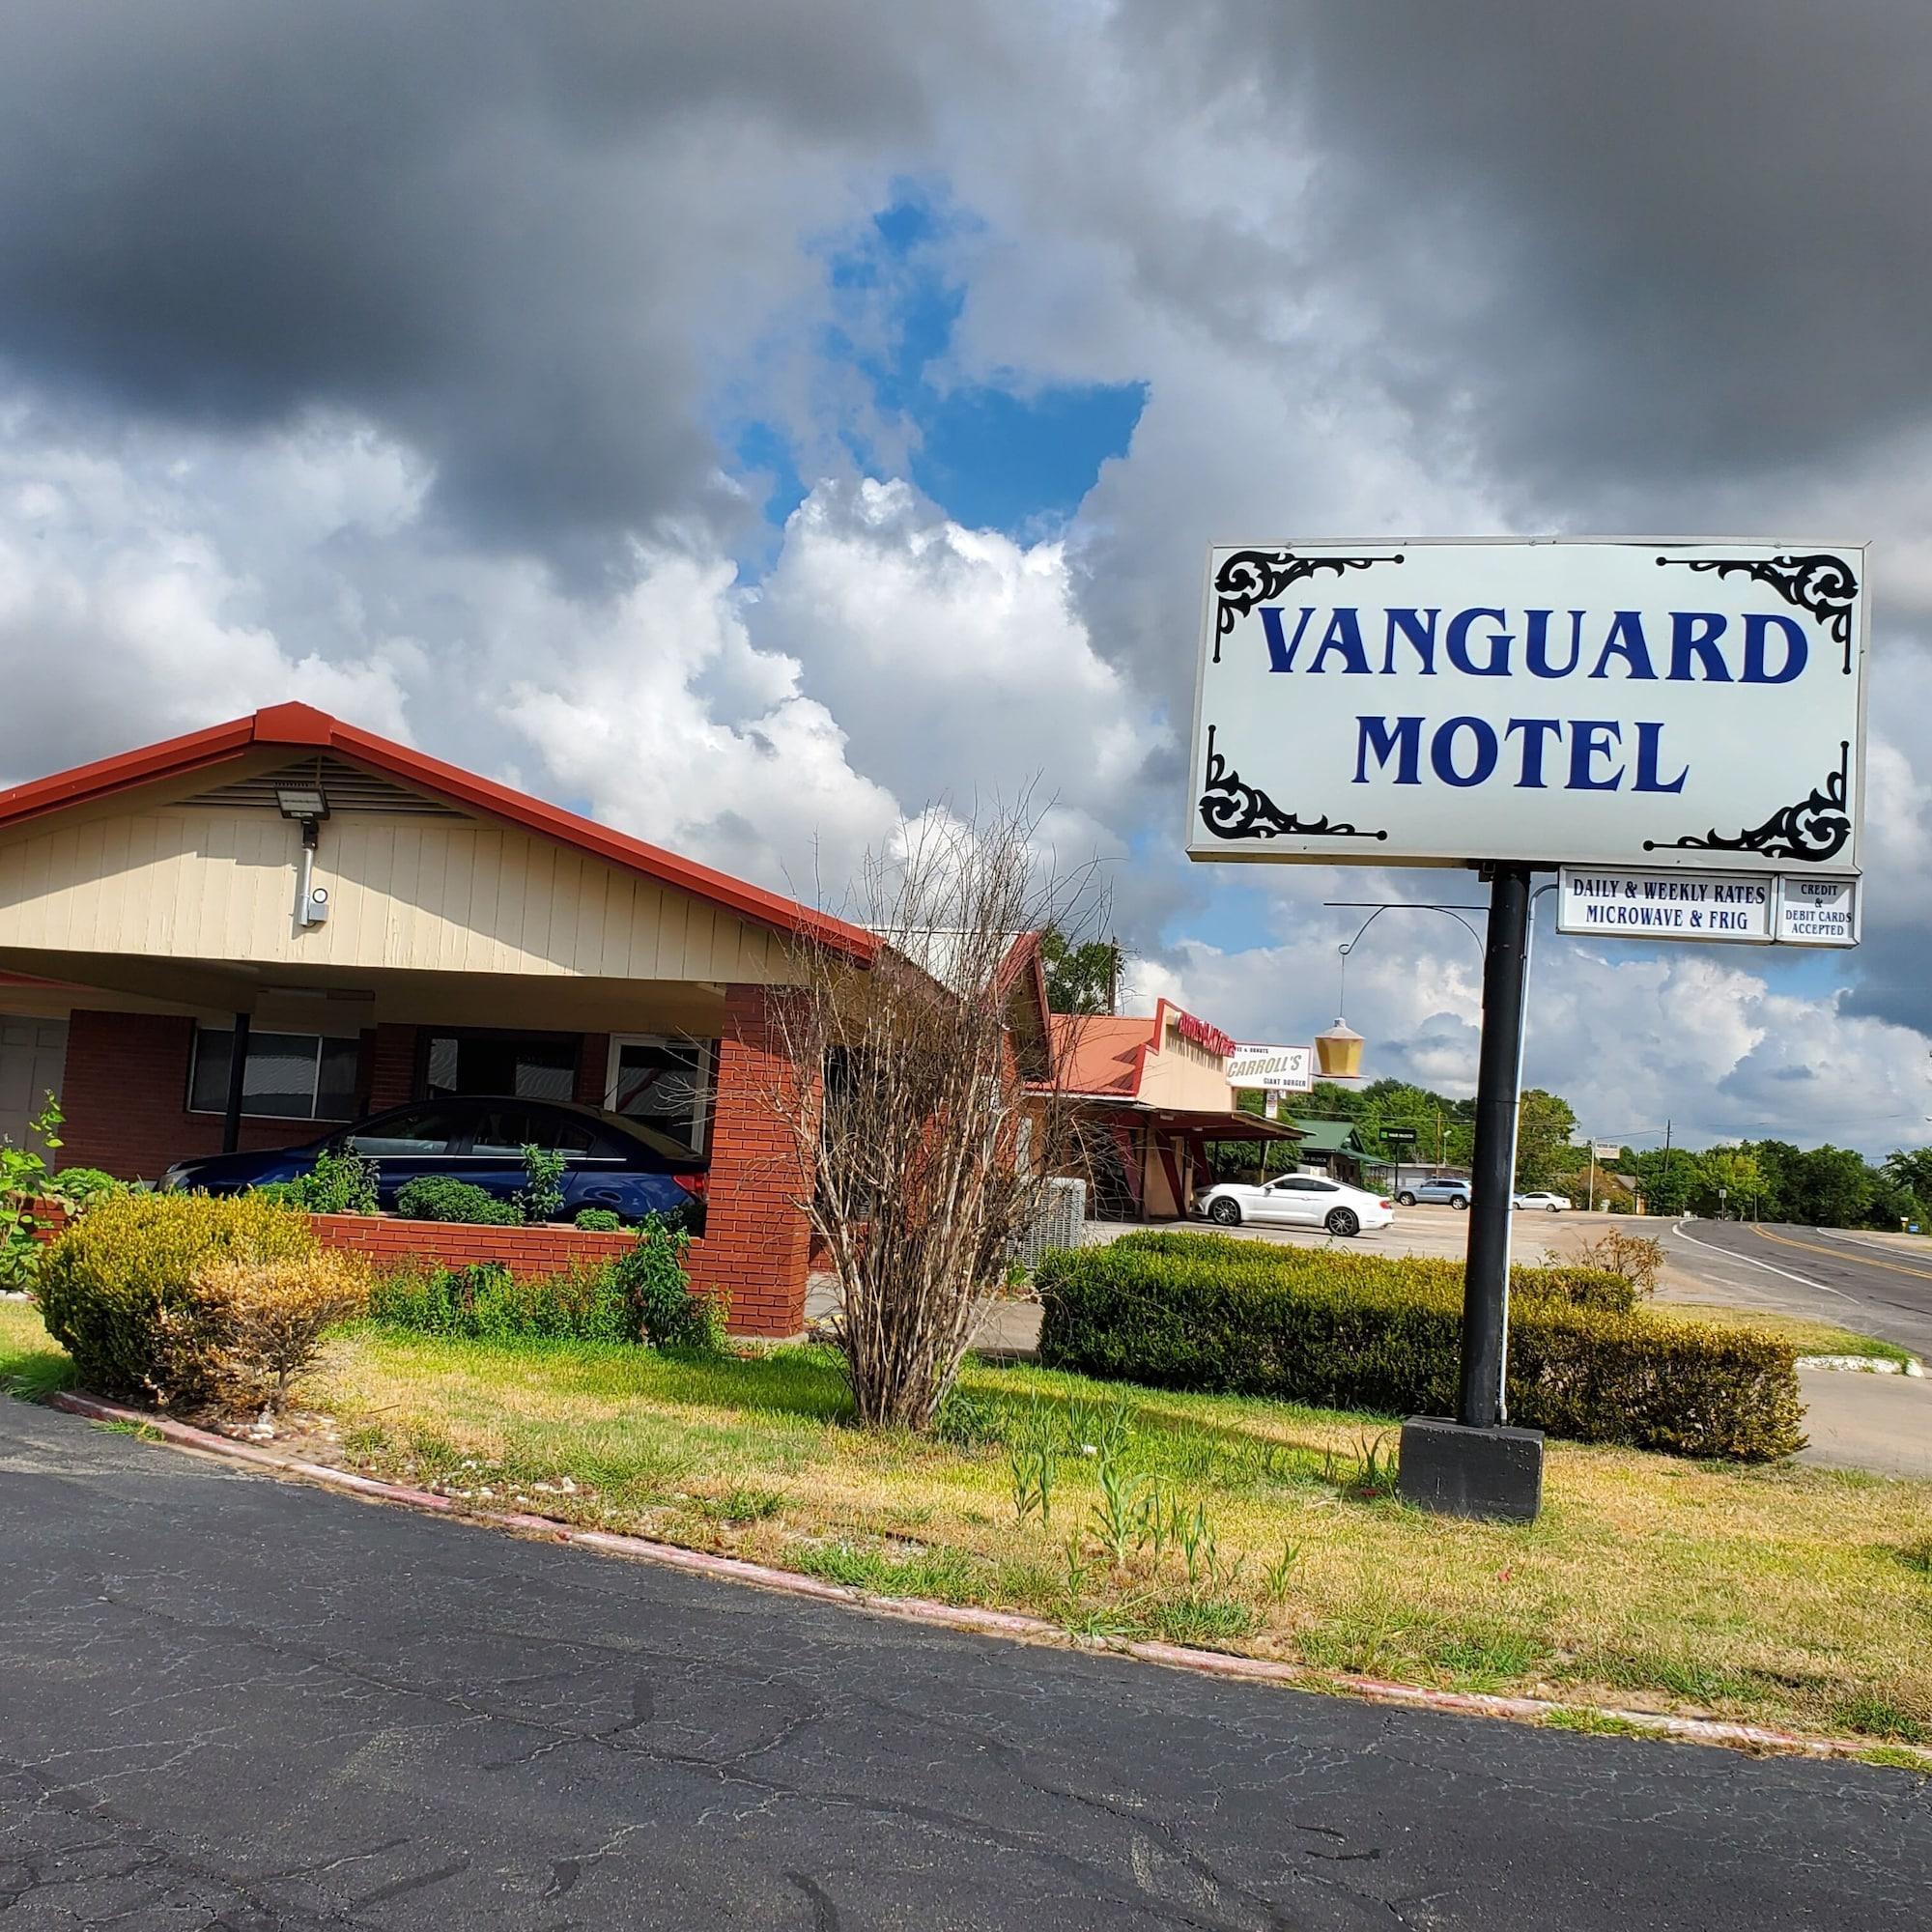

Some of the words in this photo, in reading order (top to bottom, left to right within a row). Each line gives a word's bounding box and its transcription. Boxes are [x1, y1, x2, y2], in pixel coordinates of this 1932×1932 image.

[1258, 607, 1809, 684] VANGUARD
[1351, 716, 1690, 794] MOTEL
[1573, 878, 1618, 898] DAILY
[1624, 880, 1638, 898] &
[1643, 881, 1709, 902] WEEKLY
[1714, 885, 1767, 905] RATES
[1801, 884, 1838, 896] CREDIT
[1815, 897, 1823, 908] &
[1585, 904, 1684, 926] MICROWAVE
[1690, 910, 1703, 927] &
[1709, 911, 1748, 930] FRIG
[1785, 909, 1816, 922] DEBIT
[1818, 911, 1852, 923] CARDS
[1791, 923, 1844, 936] ACCEPTED
[1227, 1054, 1302, 1078] CARROLL'S
